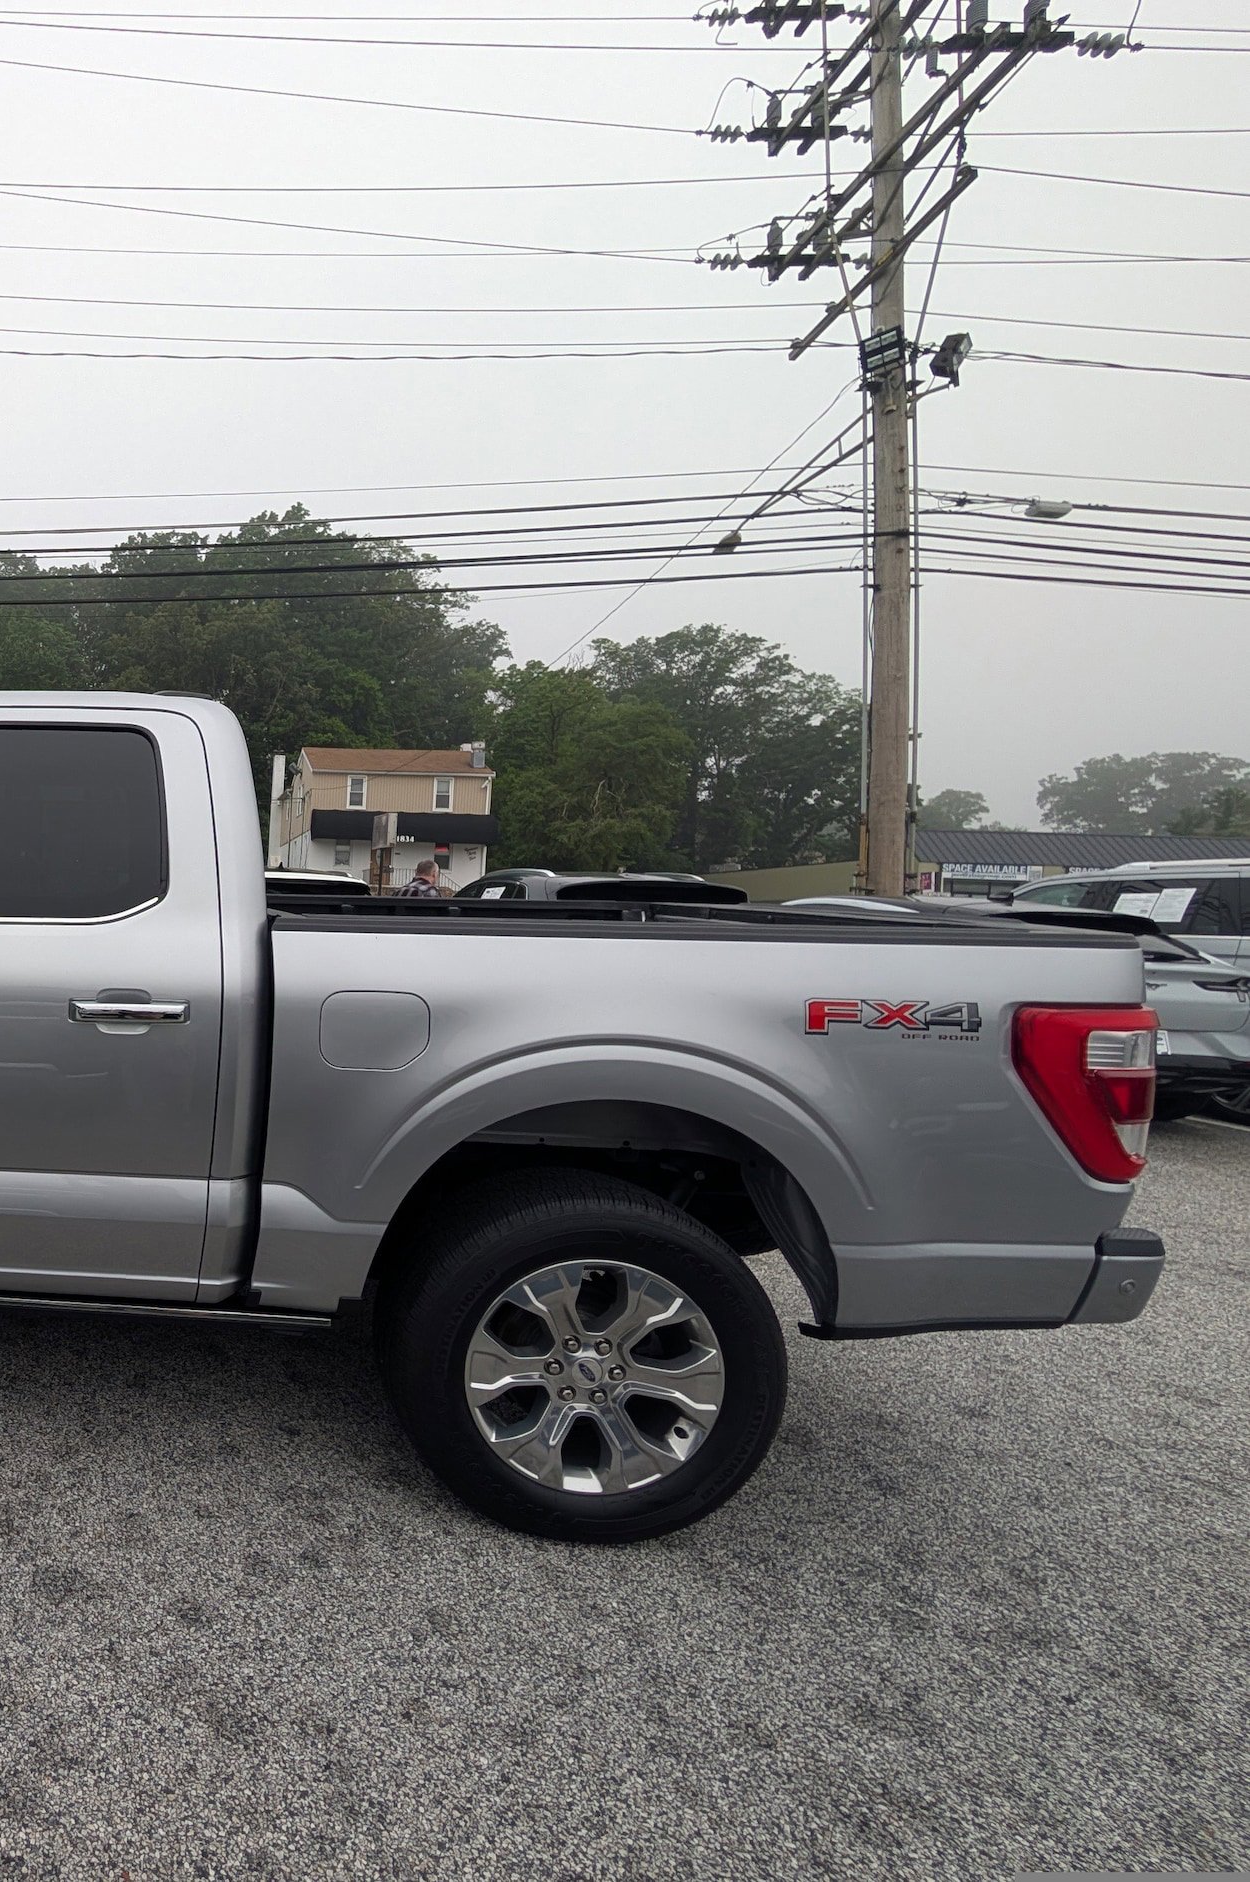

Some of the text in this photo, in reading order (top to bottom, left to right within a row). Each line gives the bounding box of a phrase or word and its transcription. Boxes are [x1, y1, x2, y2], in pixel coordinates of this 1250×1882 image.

[396, 835, 415, 843] 1834
[942, 863, 1027, 874] SPACE AVAILABLE
[804, 997, 982, 1035] FX4
